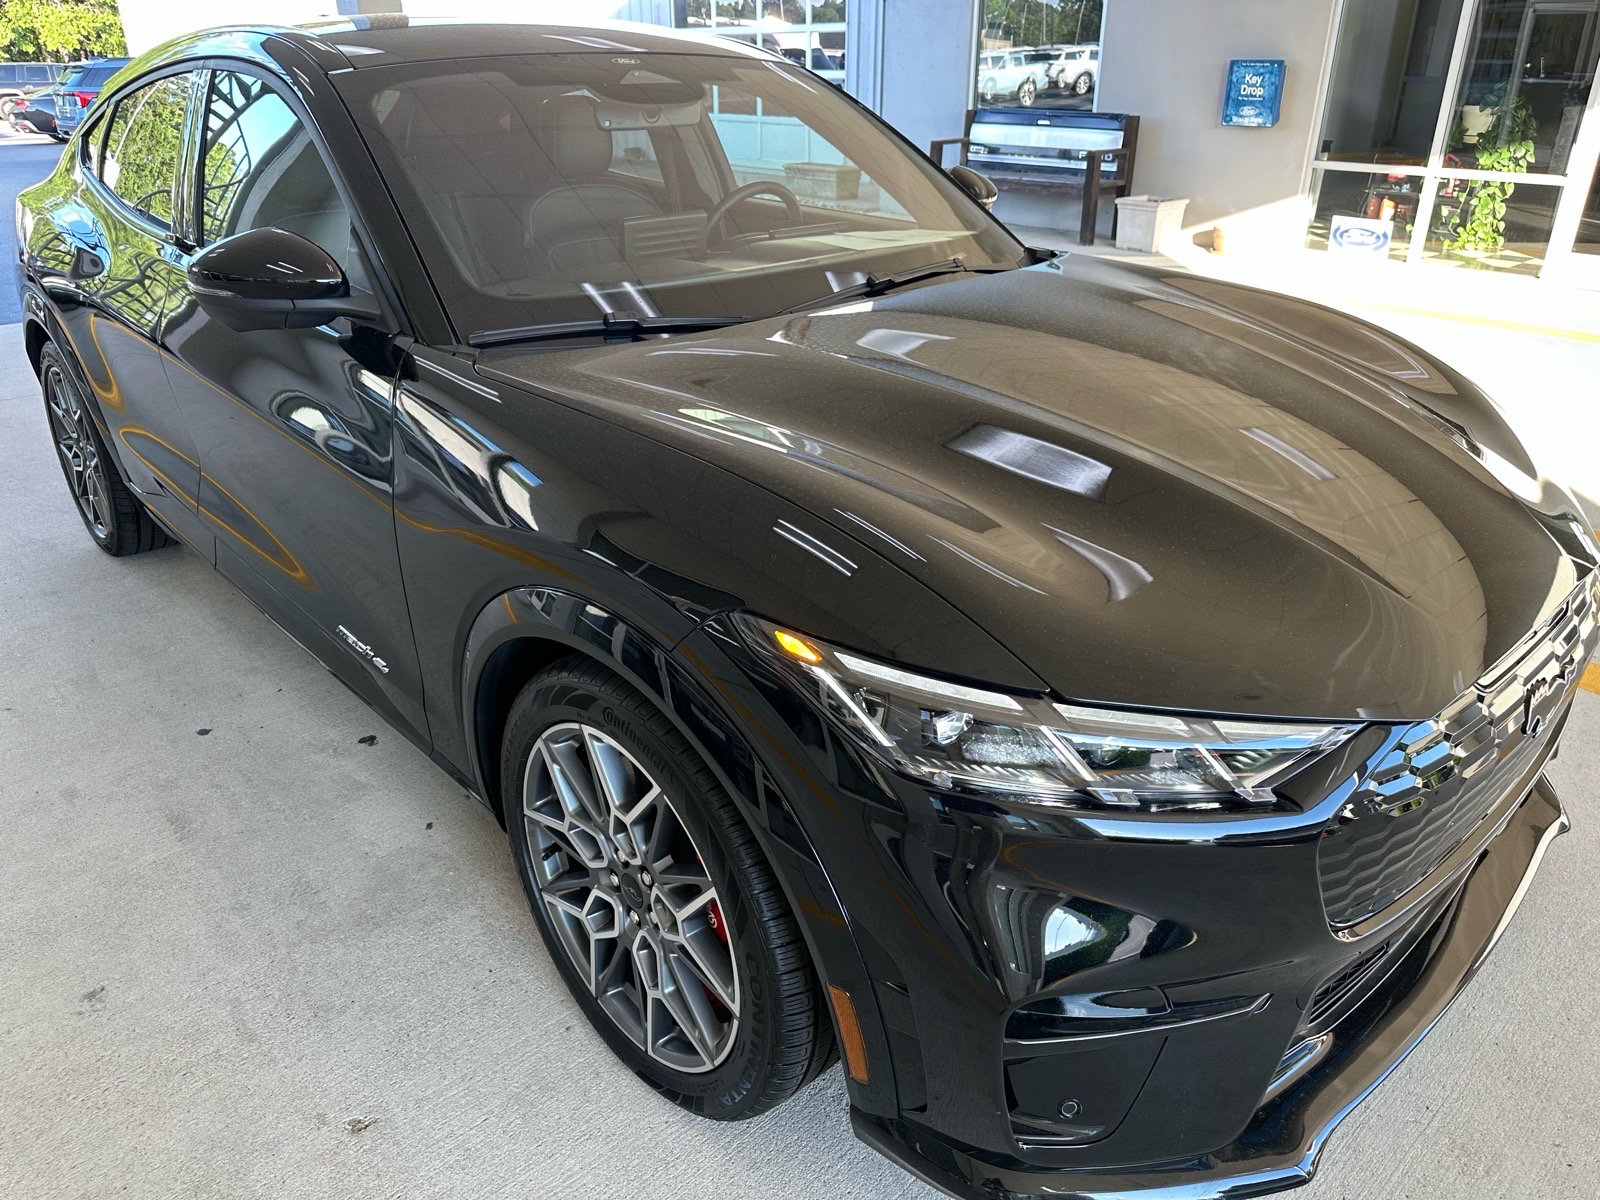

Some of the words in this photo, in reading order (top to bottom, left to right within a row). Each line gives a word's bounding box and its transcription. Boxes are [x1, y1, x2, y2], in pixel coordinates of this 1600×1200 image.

[1245, 73, 1263, 86] Key
[1240, 84, 1264, 98] Drop
[601, 705, 667, 775] Continental
